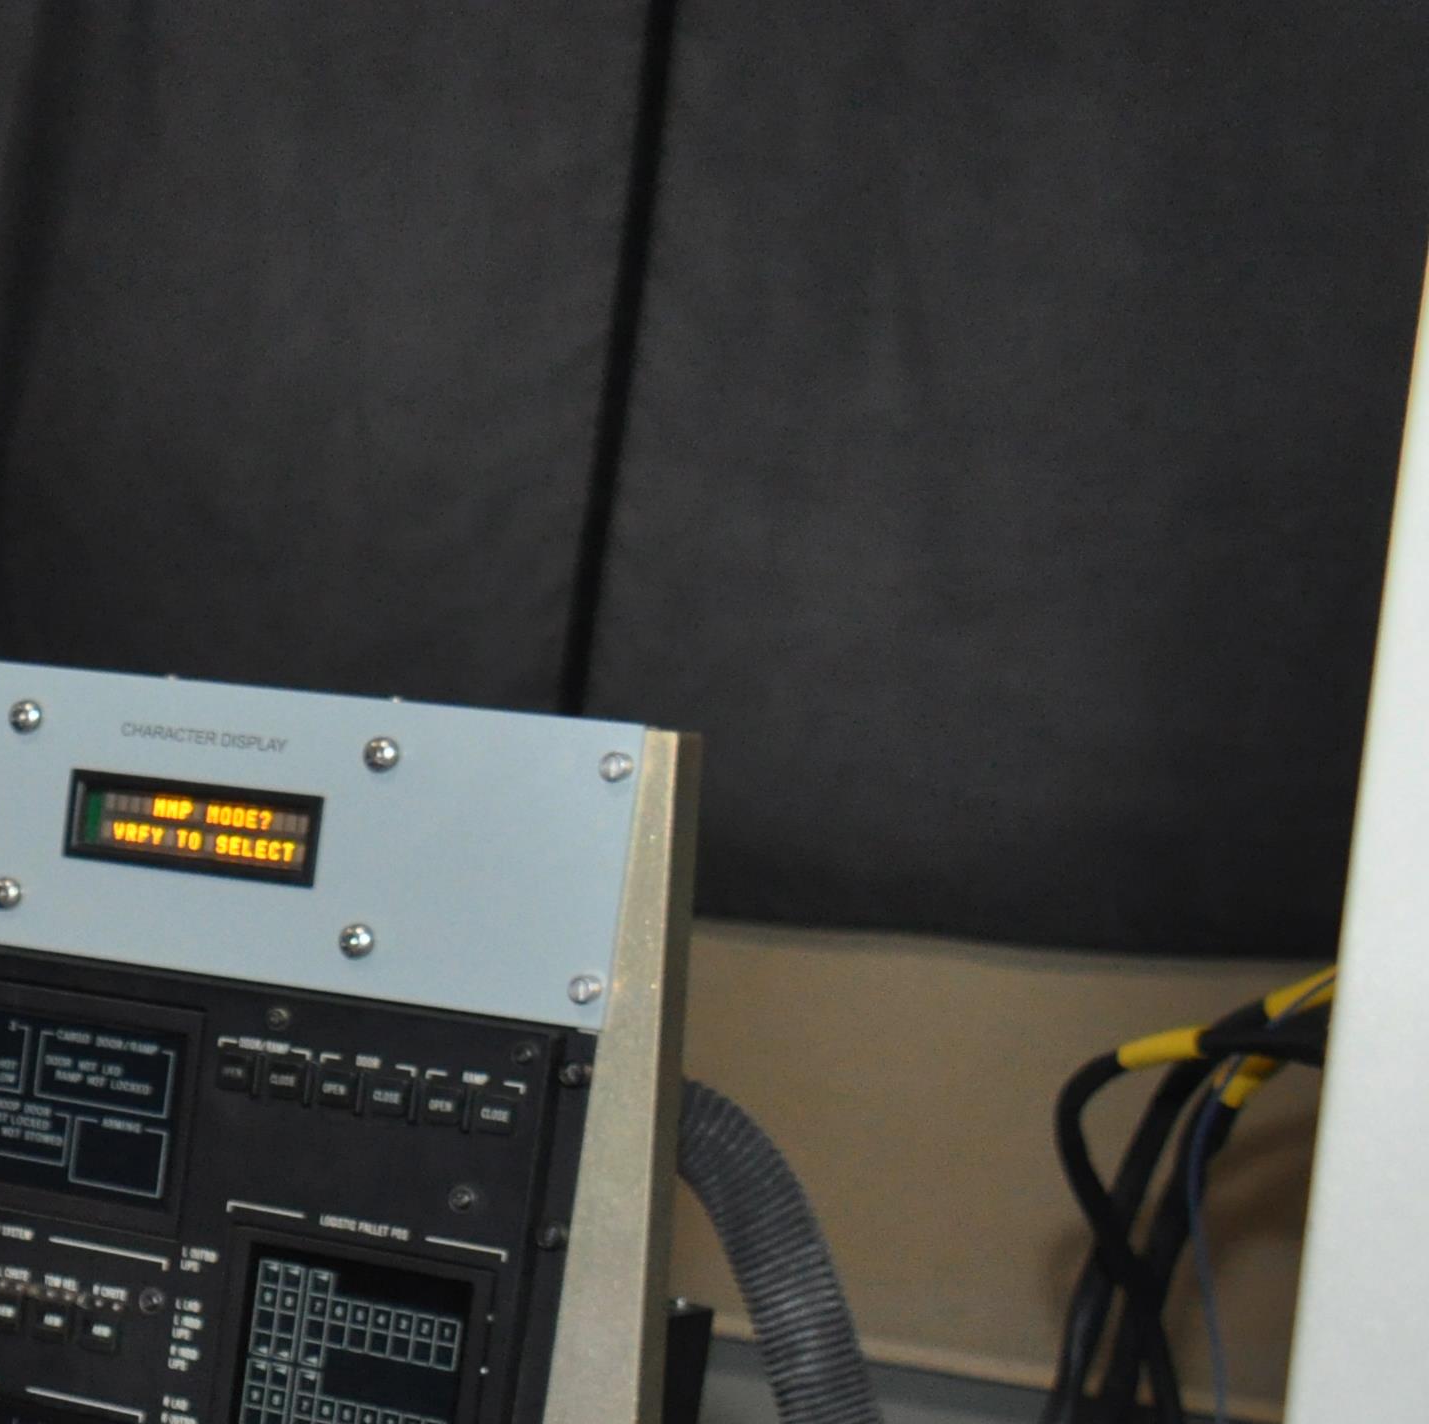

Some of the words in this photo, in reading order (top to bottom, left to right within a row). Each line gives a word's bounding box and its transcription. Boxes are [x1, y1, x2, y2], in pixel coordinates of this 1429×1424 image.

[121, 722, 216, 746] CHARACTER
[221, 733, 288, 751] DISPLAY
[206, 804, 273, 831] MODE?
[113, 821, 164, 845] VRFY
[177, 829, 202, 850] TO
[215, 835, 295, 862] SELECT
[269, 1072, 296, 1088] CLOSE
[322, 1081, 347, 1096] OPEN
[373, 1090, 401, 1105] CLOSE
[428, 1099, 453, 1113] OPEN
[481, 1107, 511, 1123] CLOSE
[358, 1220, 390, 1237] PALLET
